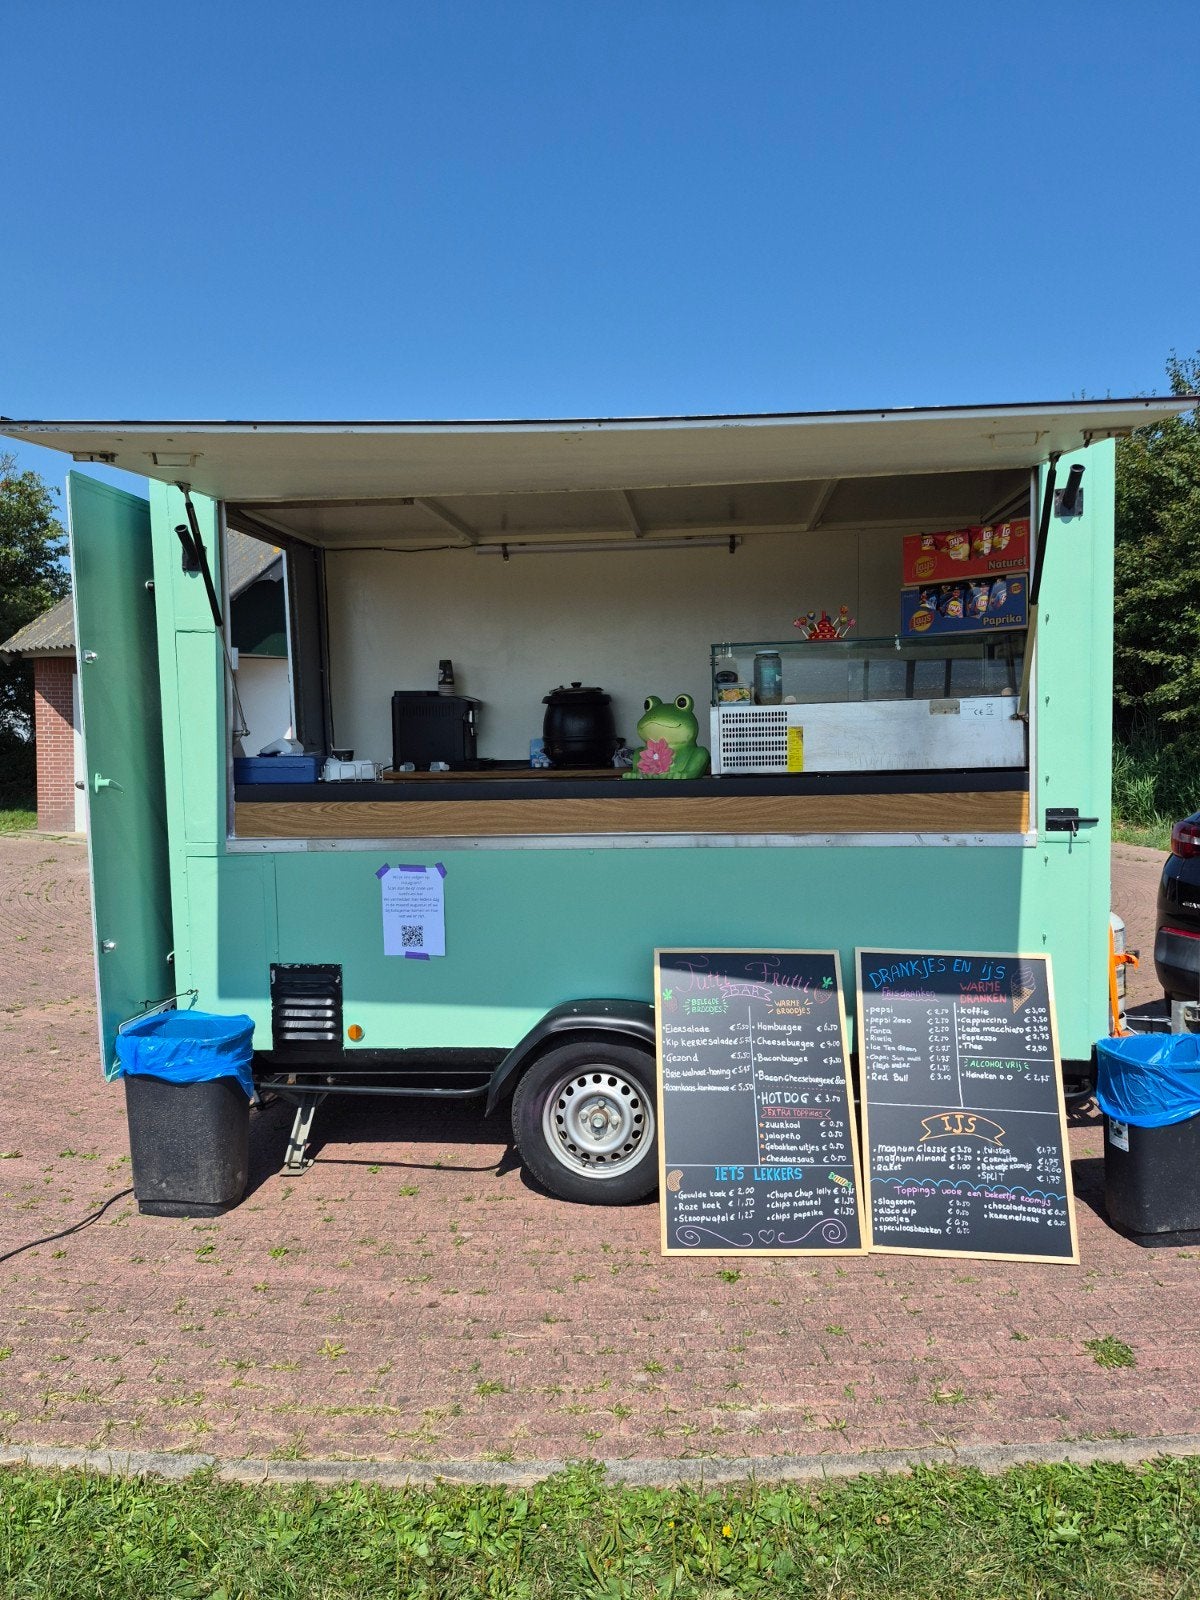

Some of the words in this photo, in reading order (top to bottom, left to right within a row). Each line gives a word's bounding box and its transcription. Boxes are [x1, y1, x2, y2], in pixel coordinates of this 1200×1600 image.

[988, 556, 1027, 570] Naturel
[983, 615, 1023, 628] Paprika
[953, 959, 972, 973] EN
[675, 955, 731, 993] Tutti
[729, 985, 760, 995] BAR
[960, 981, 1001, 993] WARME
[960, 993, 1007, 1004] DRANKEN
[758, 1022, 802, 1035] Hamburger
[870, 1025, 893, 1034] Fanta
[667, 1038, 679, 1048] Kip
[757, 1037, 815, 1051] Cheeseburger
[667, 1053, 699, 1063] Gezond
[758, 1053, 808, 1065] Baconburger
[871, 1072, 889, 1081] Red
[893, 1072, 909, 1082] Bull
[965, 1070, 998, 1080] Heineken
[767, 1108, 791, 1117] EXTRA
[940, 1114, 978, 1135] IJS
[765, 1143, 798, 1151] Gebakken
[798, 1142, 820, 1154] uitjes
[916, 1154, 947, 1162] Almond
[876, 1163, 903, 1171] Raket
[715, 1167, 745, 1181] IETS
[754, 1168, 802, 1182] LEKKERS
[710, 1190, 727, 1198] koek
[770, 1190, 793, 1200] Chupa
[816, 1187, 832, 1196] lolly
[894, 1186, 936, 1197] Toppings
[941, 1188, 962, 1196] voor
[679, 1202, 698, 1211] Roze
[702, 1201, 722, 1210] koek
[901, 1207, 918, 1217] dip
[679, 1212, 729, 1224] Stroopwafel
